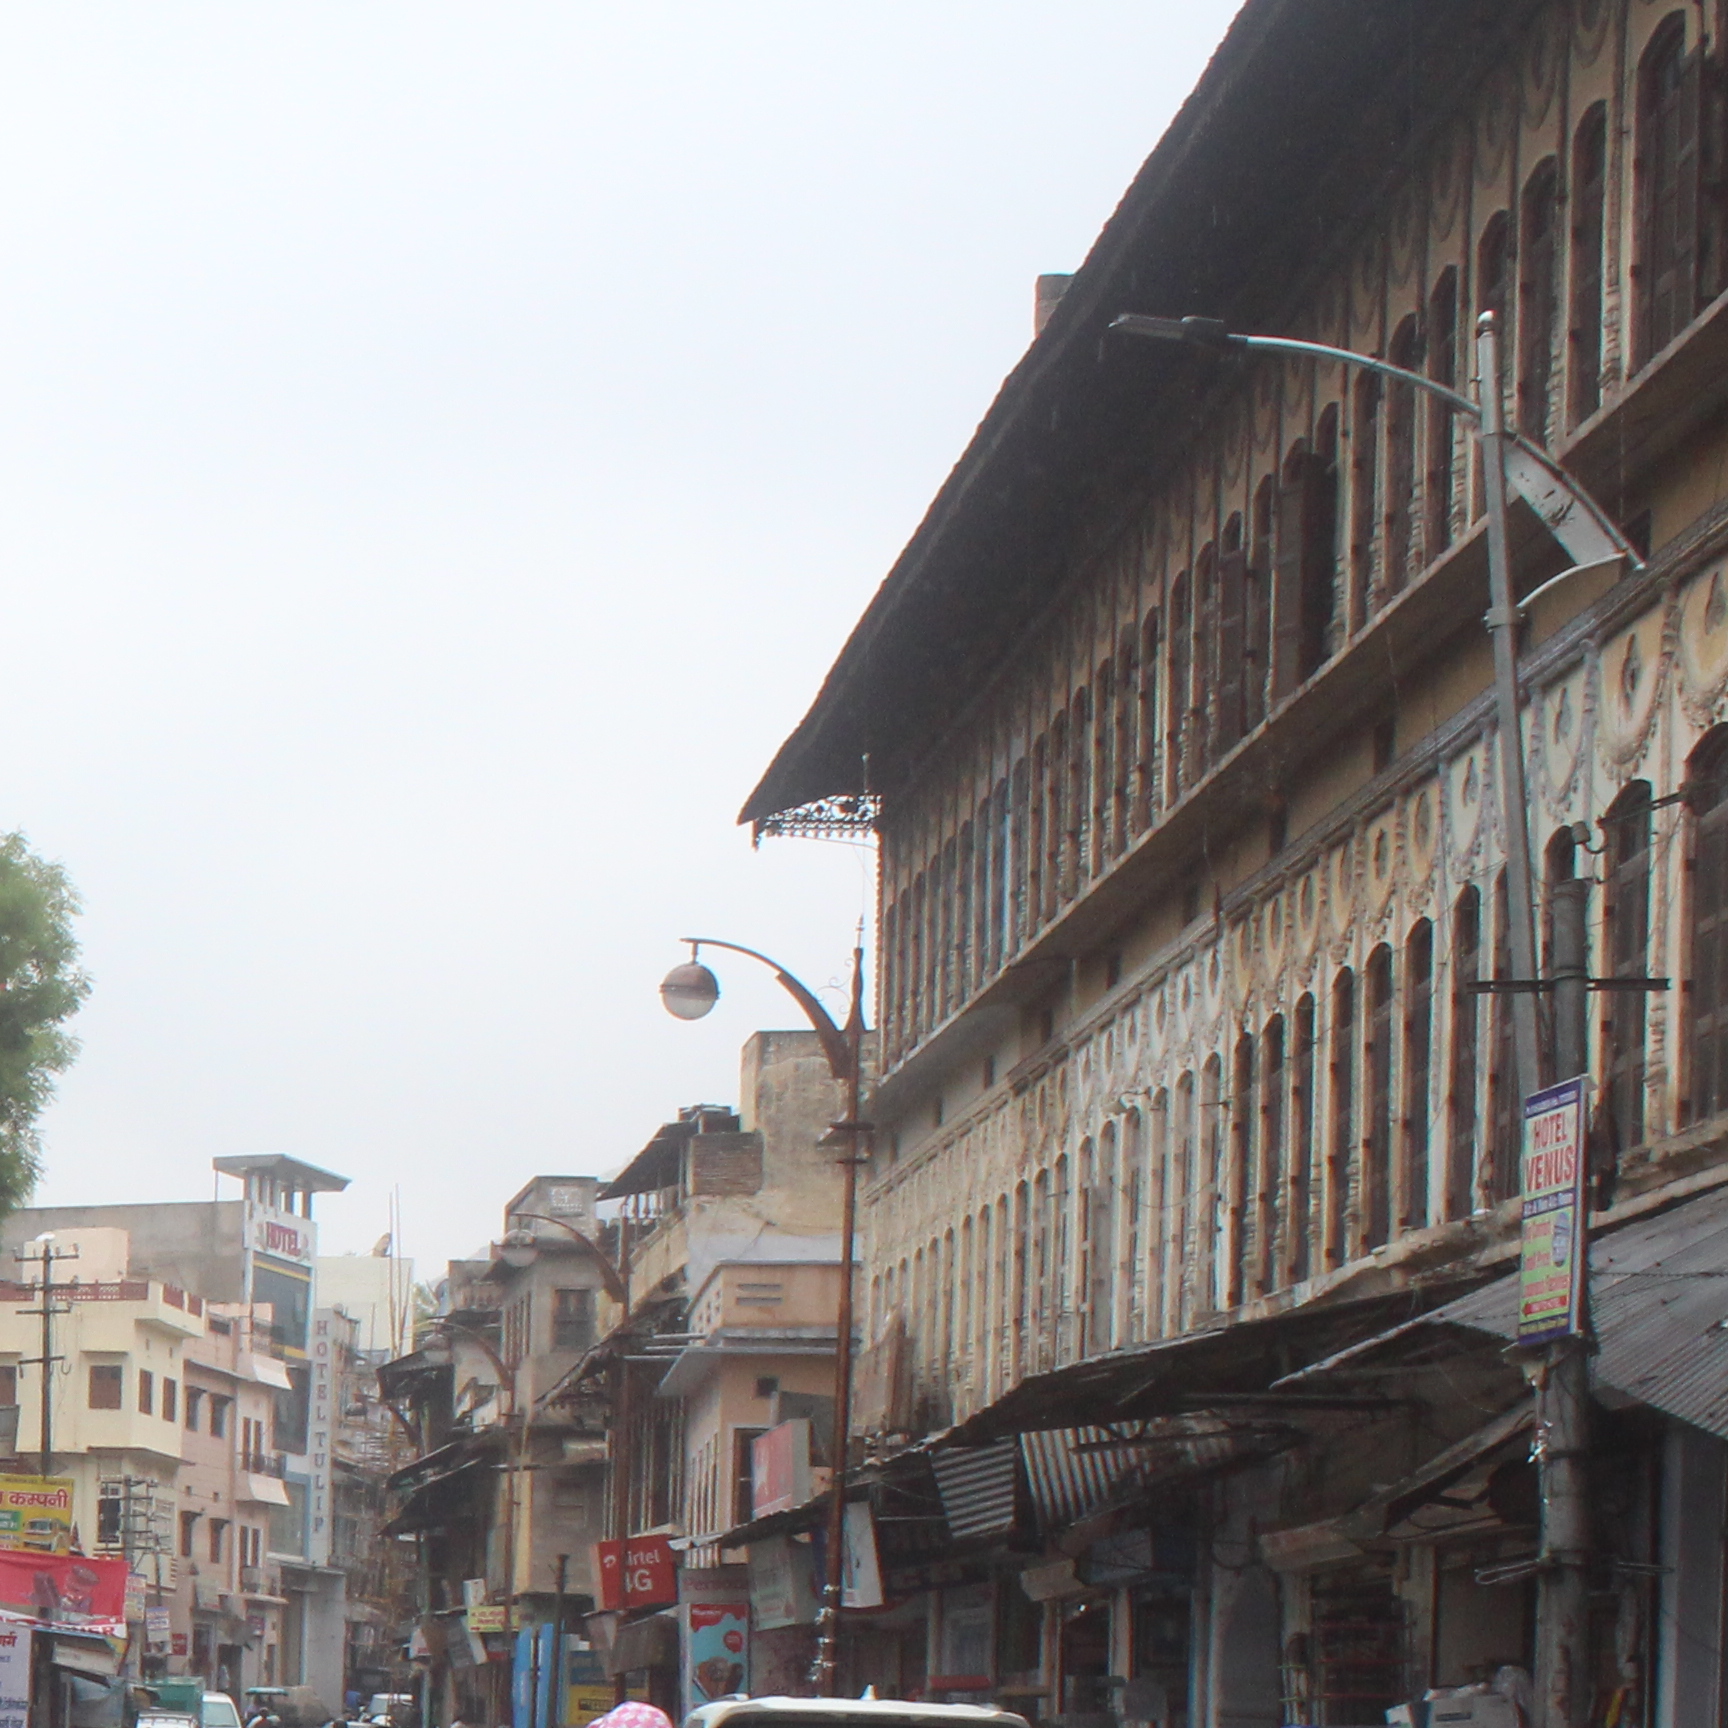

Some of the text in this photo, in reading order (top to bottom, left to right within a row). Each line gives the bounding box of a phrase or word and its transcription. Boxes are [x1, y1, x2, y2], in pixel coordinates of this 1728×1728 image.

[1534, 1112, 1568, 1150] HOTEL
[1526, 1145, 1575, 1192] VENUS
[312, 1320, 328, 1533] HOTEL TULIP
[8, 1488, 69, 1509] कम्पनी
[626, 1549, 660, 1566] irtel
